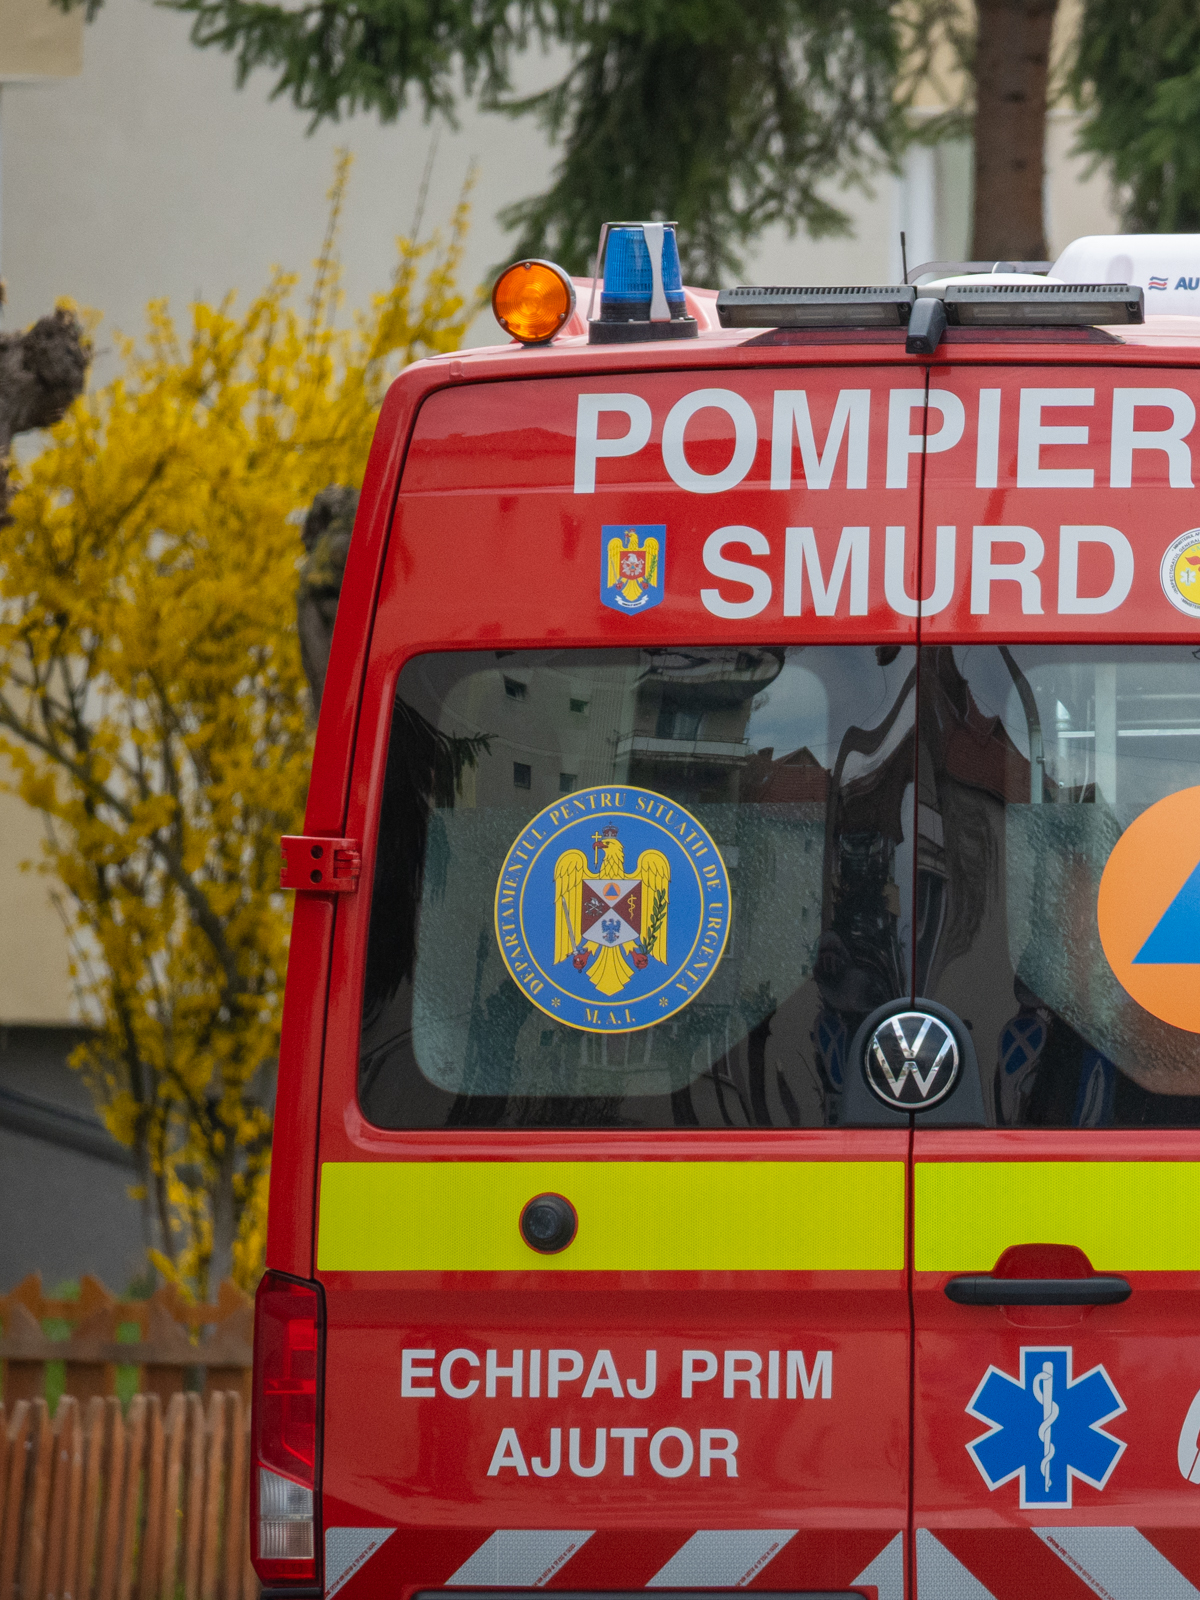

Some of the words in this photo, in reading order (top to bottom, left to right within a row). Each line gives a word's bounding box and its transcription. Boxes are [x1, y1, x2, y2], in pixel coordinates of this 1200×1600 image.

[700, 525, 1134, 619] SMURD
[501, 828, 547, 995] DEPARTAMENTUL
[549, 792, 627, 826] PENTRU
[702, 863, 721, 892] DE
[400, 1348, 658, 1400] ECHIPAJ
[681, 1349, 833, 1399] PRIM
[486, 1427, 740, 1478] AJUTOR
